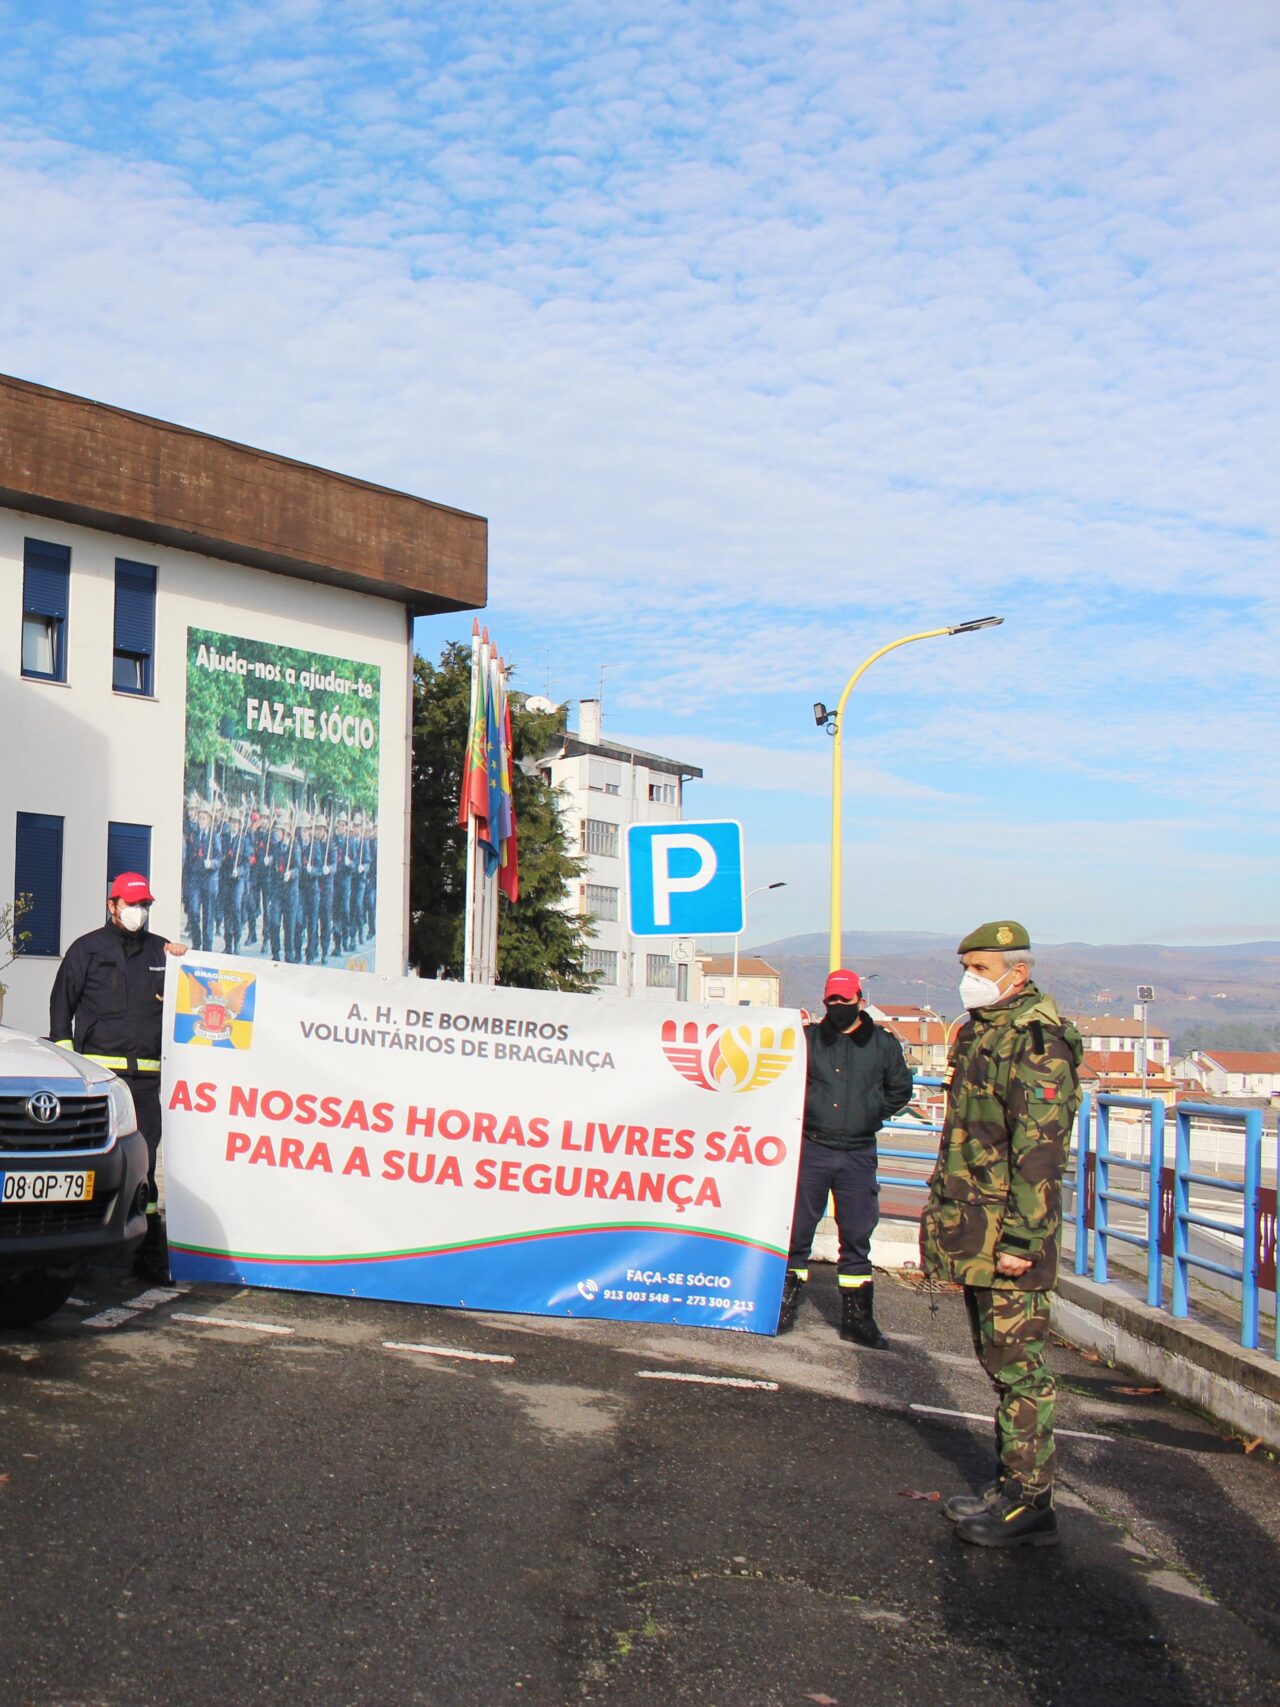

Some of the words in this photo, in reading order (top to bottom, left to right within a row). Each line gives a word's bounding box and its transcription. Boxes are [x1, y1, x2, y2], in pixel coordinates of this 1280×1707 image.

[195, 644, 282, 682] Ajuda-nos
[285, 668, 296, 685] a
[299, 667, 373, 699] ajudar-te
[246, 698, 315, 740] FAZ-TE
[320, 705, 375, 749] SÓCIO
[651, 833, 717, 926] P
[300, 1021, 456, 1055] VOLUNTÁRIOS
[462, 1038, 488, 1059] DE
[494, 1041, 616, 1072] BRAGANÇA
[347, 1003, 368, 1022] A.
[375, 1006, 398, 1026] H.
[405, 1009, 433, 1029] DE
[439, 1013, 569, 1041] BOMBEIROS
[168, 1079, 218, 1113] AS
[228, 1085, 395, 1134] NOSSAS
[406, 1105, 550, 1148] HORAS
[560, 1120, 696, 1160] LIVRES
[703, 1125, 787, 1167] SÃO
[225, 1131, 333, 1173] PARA
[341, 1146, 371, 1178] A
[381, 1150, 464, 1187] SUA
[473, 1158, 722, 1213] SEGURANÇA
[603, 1289, 624, 1300] 913
[626, 1291, 647, 1302] 003
[648, 1292, 670, 1303] 548
[686, 1295, 706, 1306] 273
[708, 1297, 730, 1308] 300
[732, 1299, 754, 1312] 213
[626, 1269, 684, 1286] FAÇA-SE
[686, 1272, 731, 1288] SÓCIO
